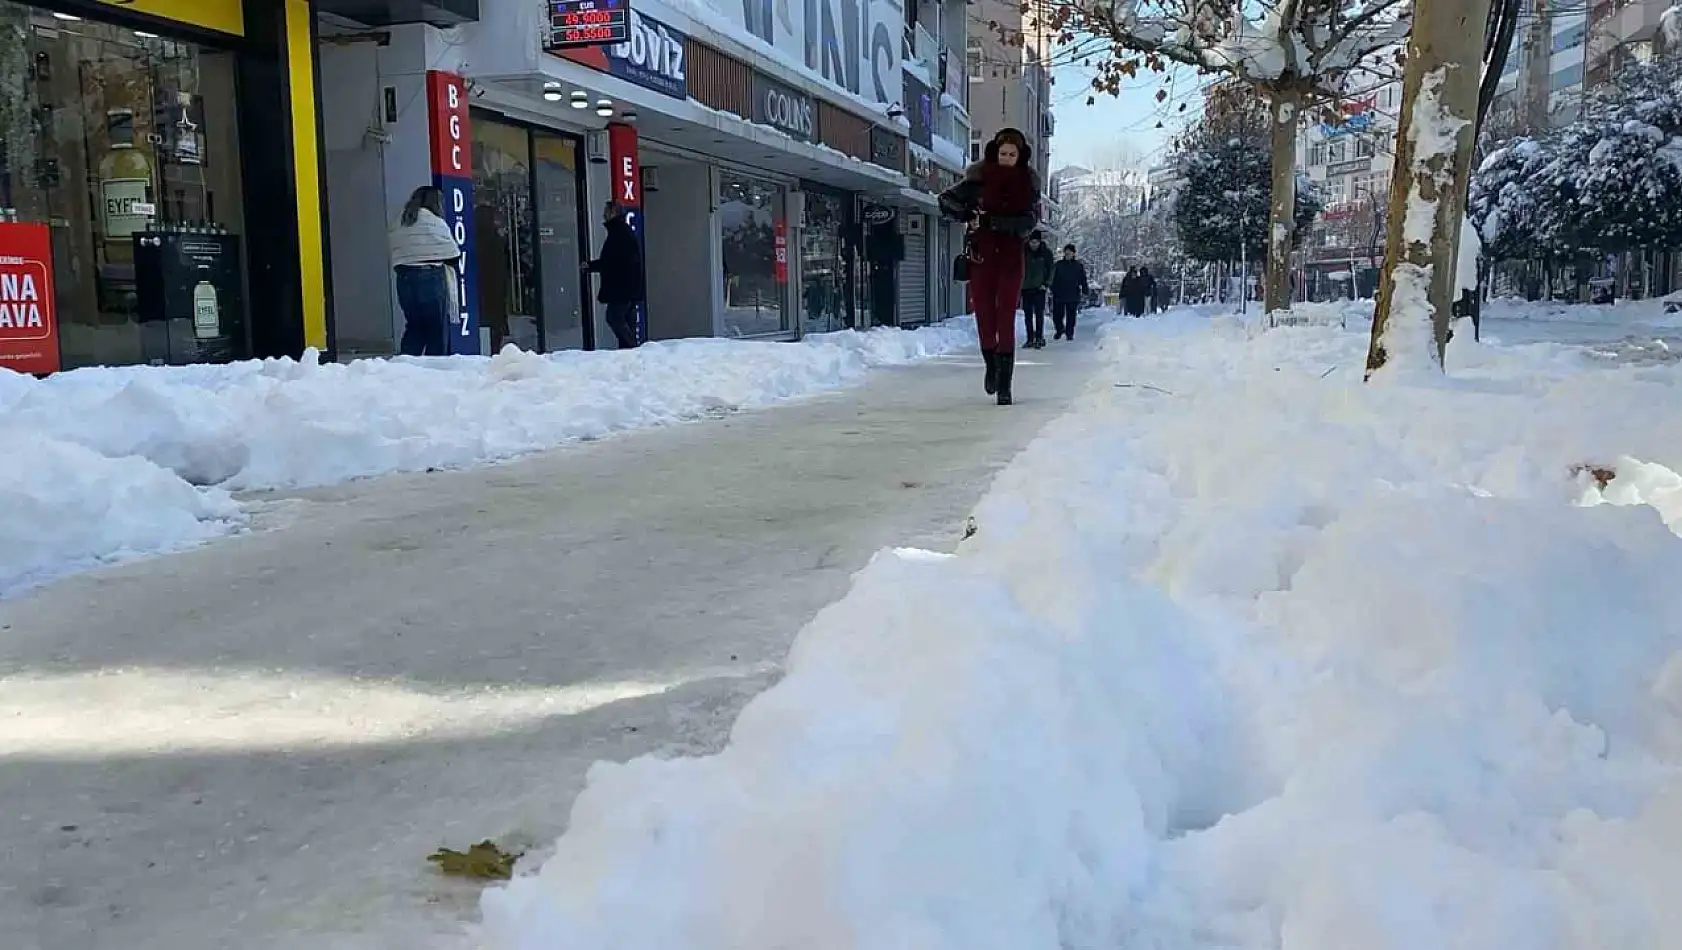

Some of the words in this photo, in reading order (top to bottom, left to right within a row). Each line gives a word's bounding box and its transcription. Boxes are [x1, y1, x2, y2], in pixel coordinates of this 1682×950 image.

[611, 8, 684, 80] ÖVİZ
[447, 84, 462, 171] BGC
[0, 273, 38, 301] NA
[453, 187, 470, 336] DÖVİZ
